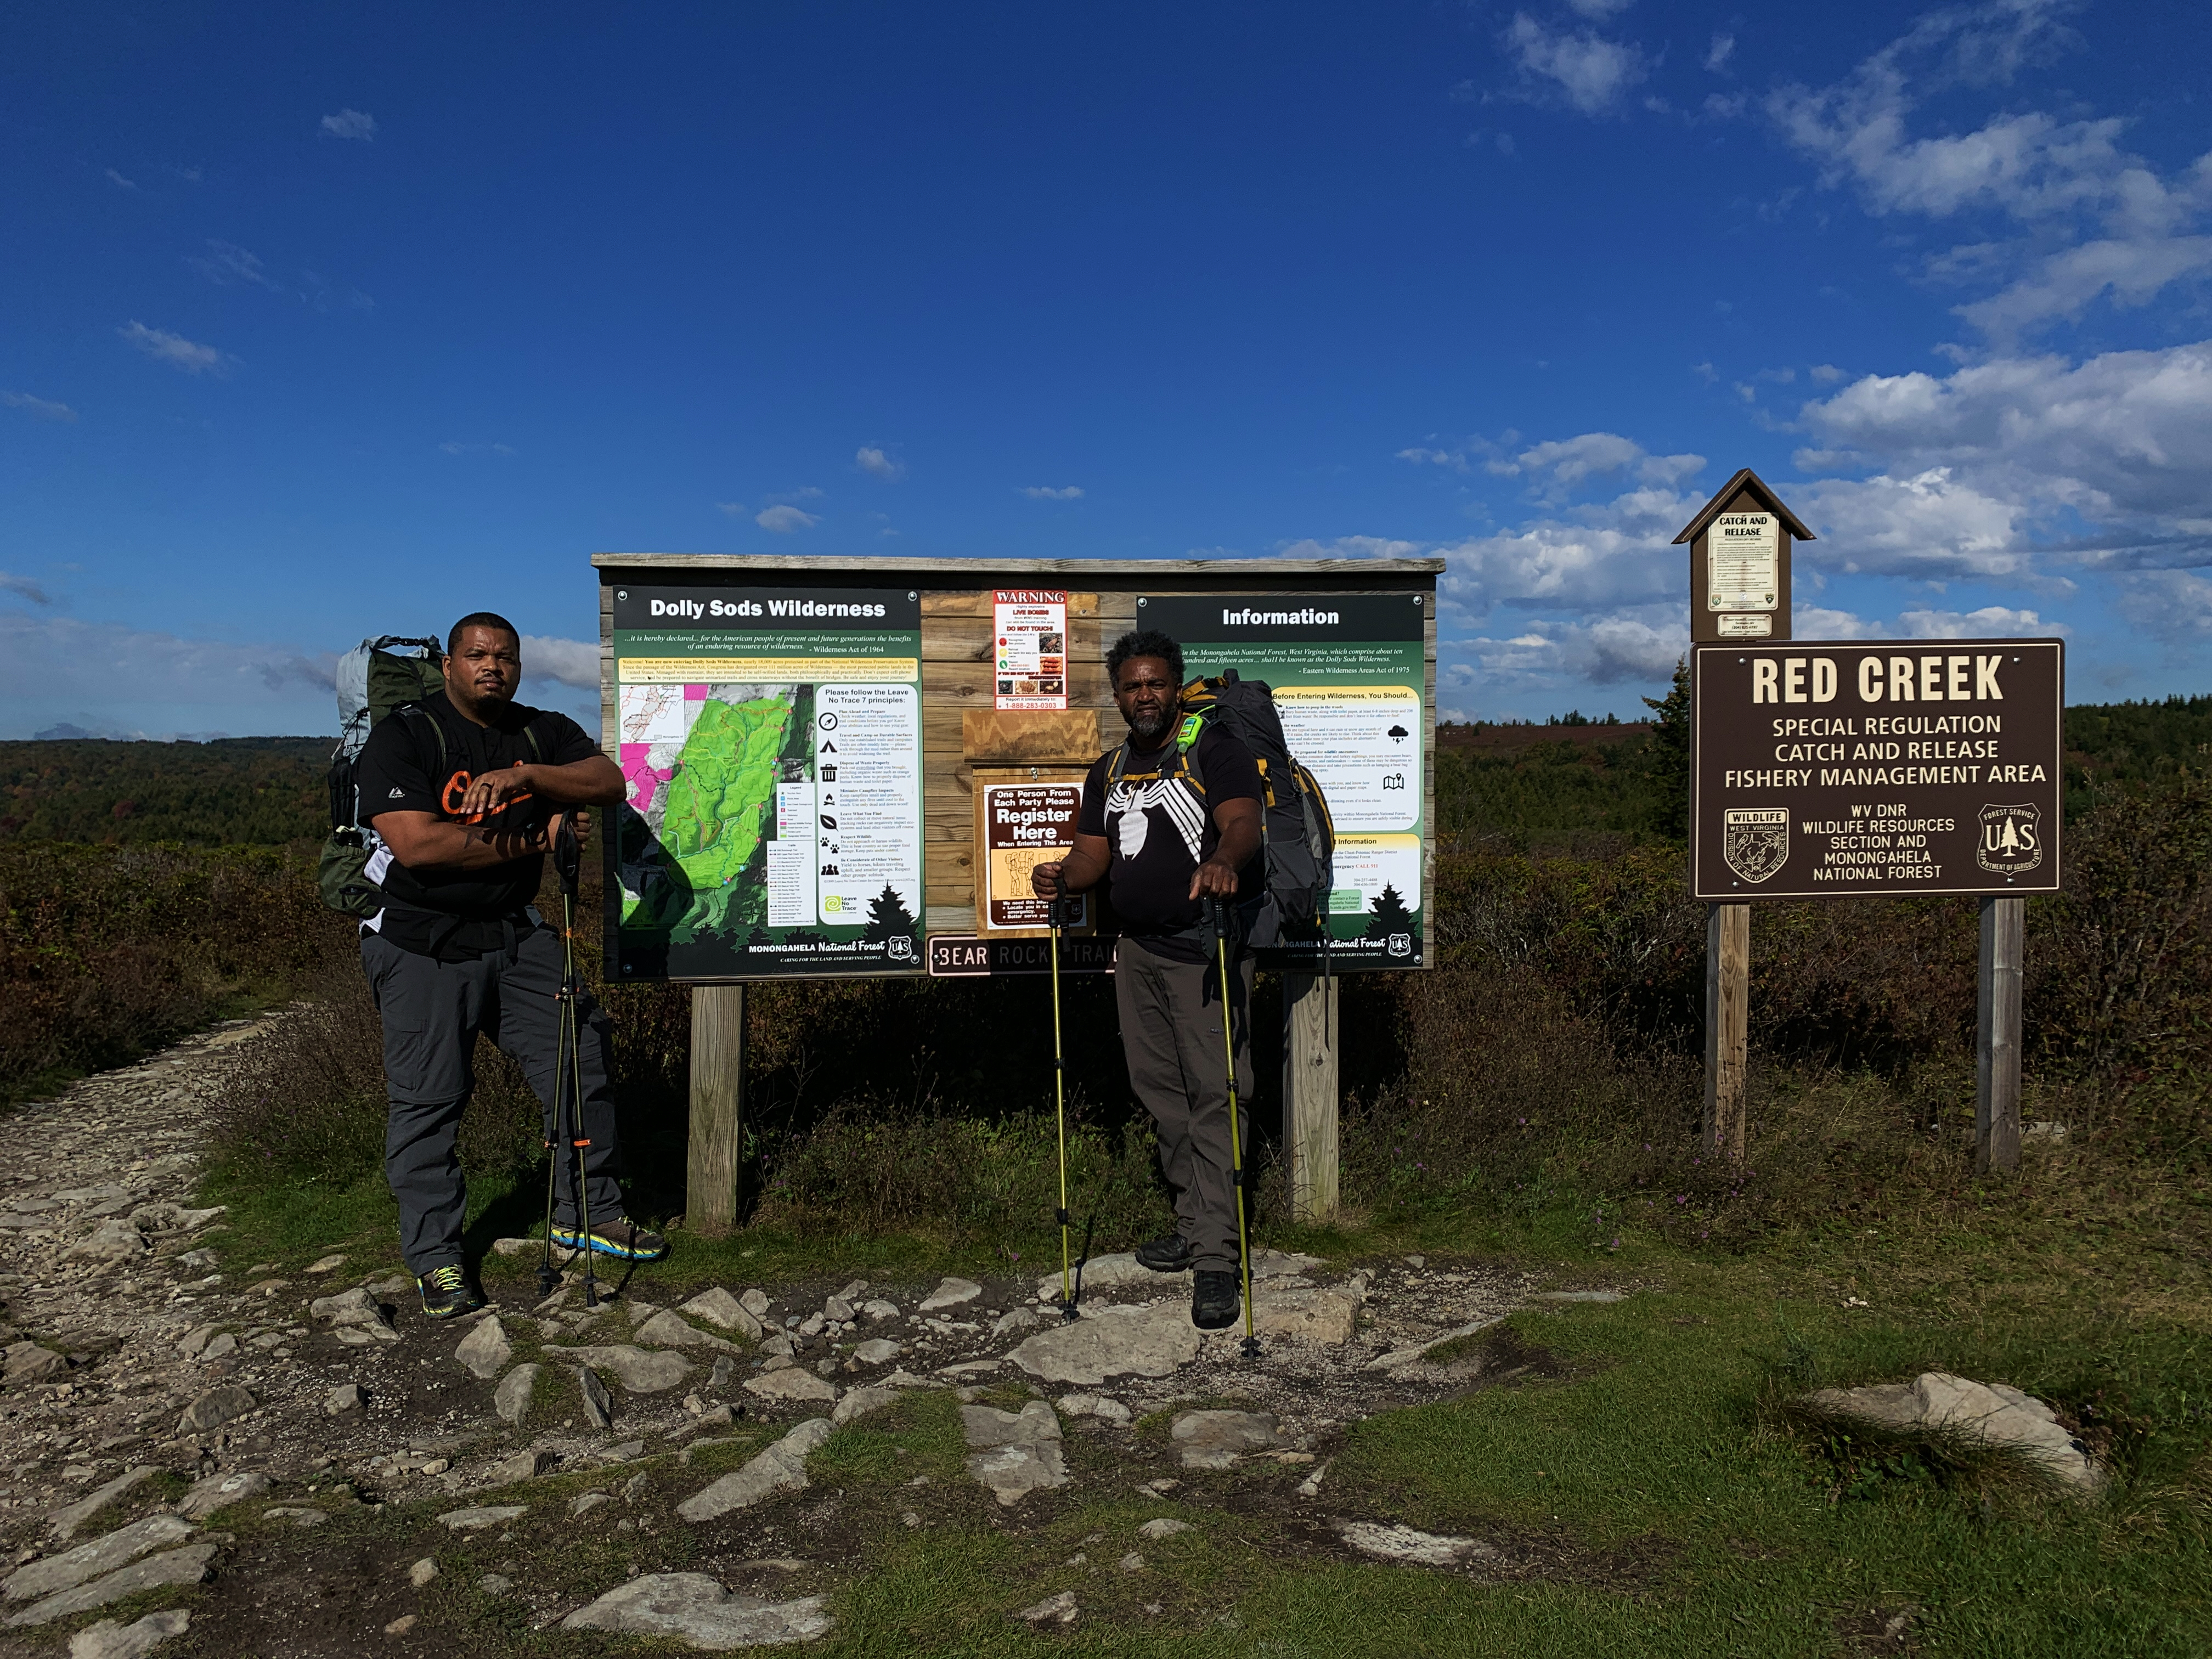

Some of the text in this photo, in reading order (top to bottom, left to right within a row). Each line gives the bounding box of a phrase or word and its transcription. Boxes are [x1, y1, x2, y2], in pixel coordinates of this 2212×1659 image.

[996, 591, 1065, 603] WARNING
[651, 600, 885, 619] Dolly Sods Wilderness
[1223, 608, 1339, 624] Information
[754, 635, 776, 643] people
[1753, 656, 2003, 703] RED CREEK
[1773, 715, 2000, 736] SPECIAL REGULATION
[1775, 741, 1998, 761] CATCH AND RELEASE
[1726, 765, 2046, 787] FISHERY MANAGEMENT AREA
[997, 808, 1072, 826] Register
[1733, 812, 1781, 822] WILDLIFE
[1852, 804, 1906, 817] WV DNR
[1983, 808, 2035, 820] FOREST SERVICE
[1013, 826, 1057, 839] Here
[1803, 819, 1954, 834] WILDLIFE RESOURCES
[1831, 835, 1926, 849] SECTION AND
[1733, 862, 1743, 871] OF
[1742, 870, 1772, 880] NATURAL
[1770, 831, 1786, 870] RESOURCES
[1825, 850, 1931, 865] MONONGAHELA
[1980, 849, 2006, 870] DEPARTMENT
[1814, 866, 1942, 881] NATIONAL FOREST
[749, 940, 885, 953] MONONGAHELA National Forest
[939, 947, 986, 965] BEAR
